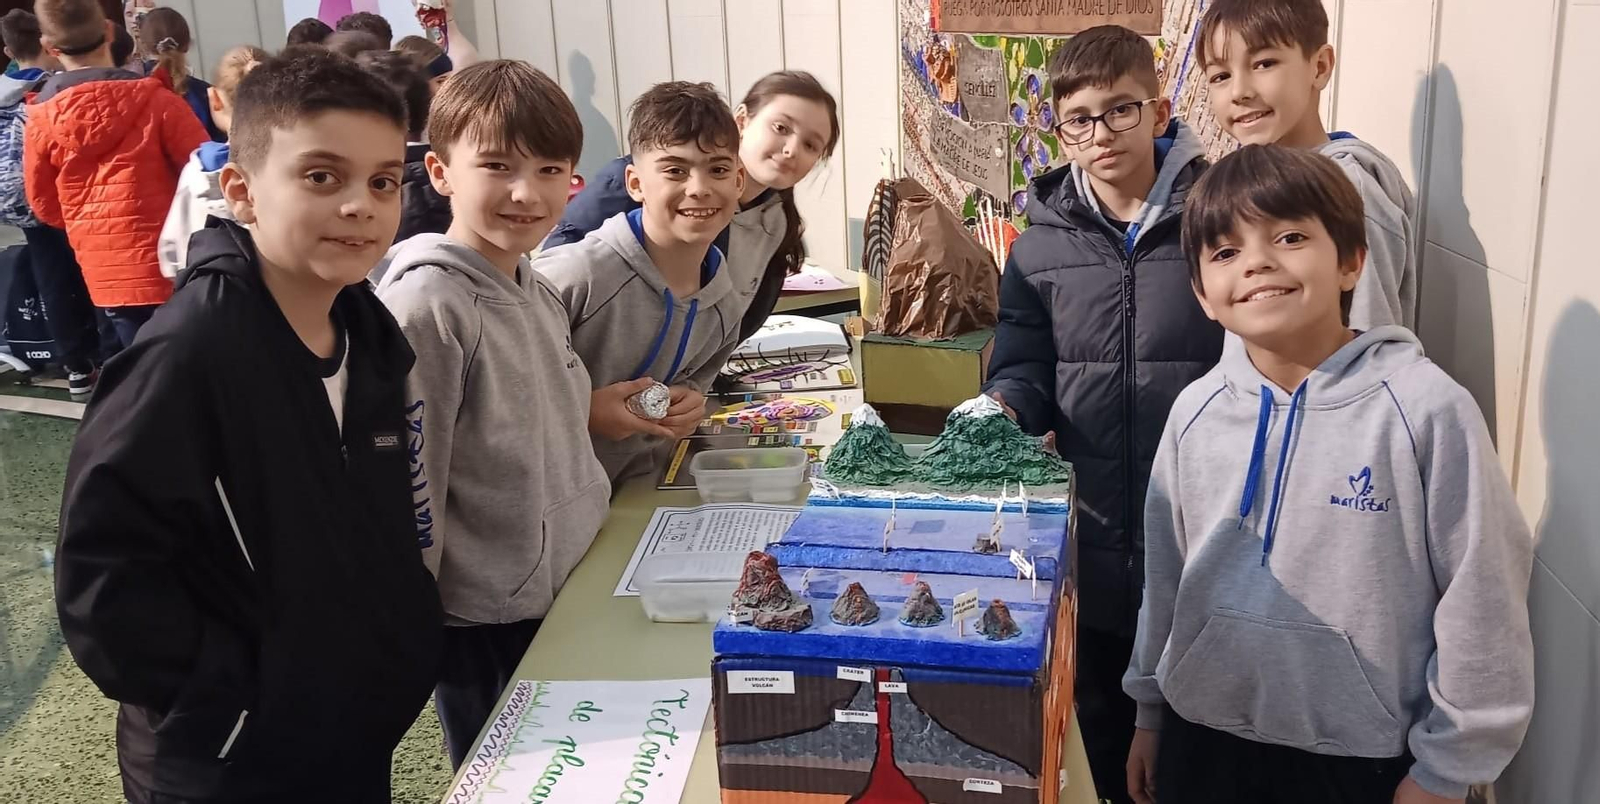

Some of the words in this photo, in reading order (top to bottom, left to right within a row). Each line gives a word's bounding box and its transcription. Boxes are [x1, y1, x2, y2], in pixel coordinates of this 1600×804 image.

[1035, 0, 1064, 16] SANTA
[1067, 0, 1105, 16] MADRE
[1107, 0, 1122, 15] DE
[1125, 0, 1155, 15] DIOS
[1330, 494, 1391, 512] maristas
[568, 701, 604, 722] de
[968, 778, 995, 786] CORTEZA
